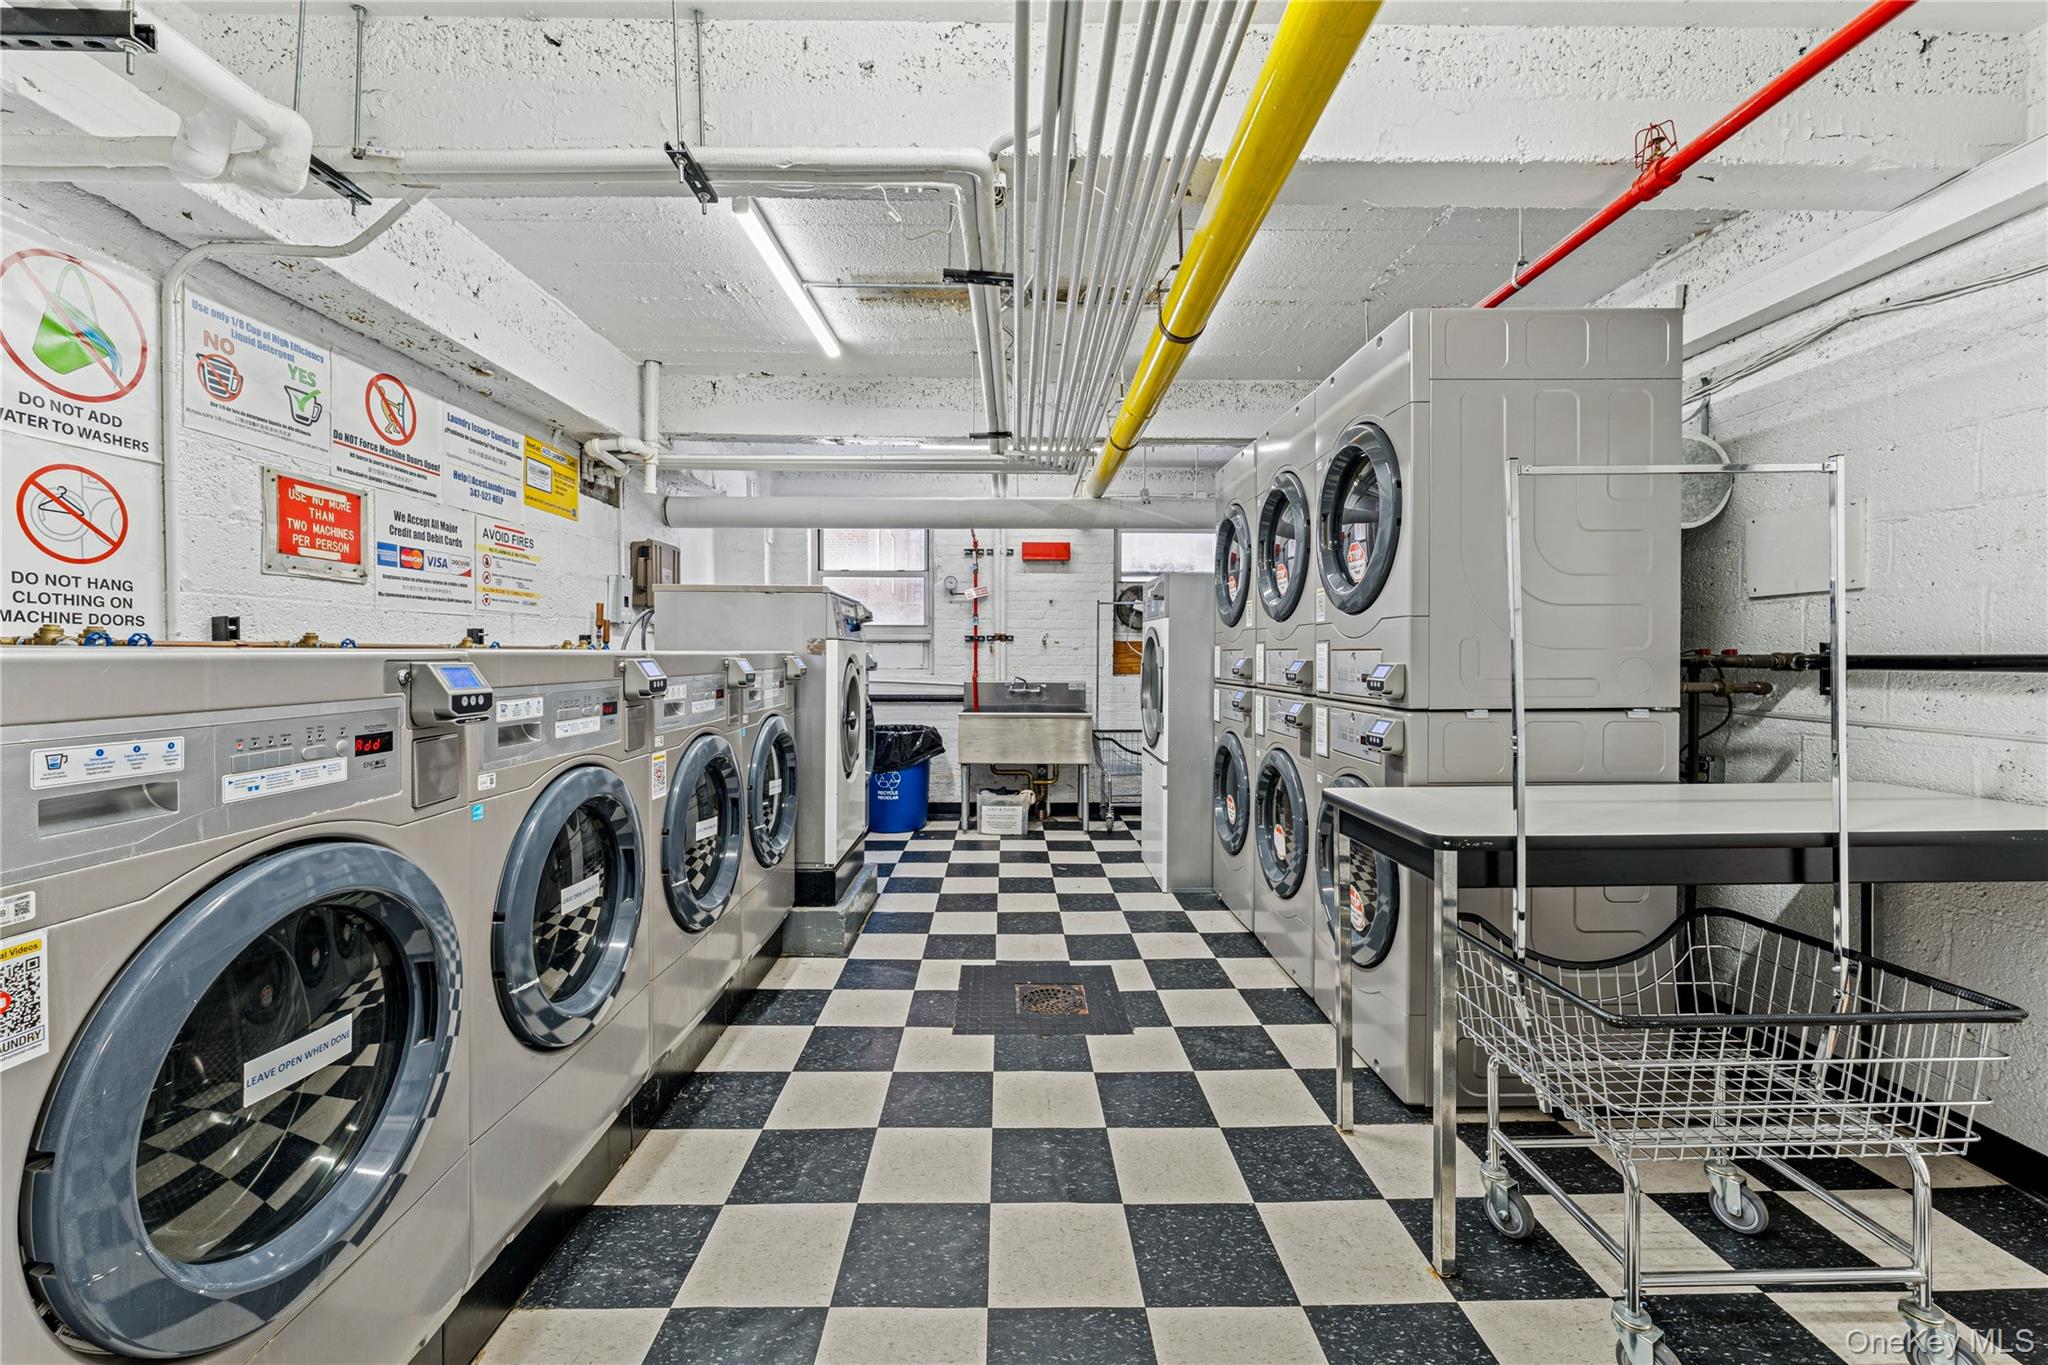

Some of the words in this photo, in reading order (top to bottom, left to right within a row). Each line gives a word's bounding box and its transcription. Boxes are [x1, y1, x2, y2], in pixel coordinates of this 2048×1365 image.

[192, 299, 208, 314] Use
[210, 308, 230, 324] only
[231, 316, 244, 330] 1/8
[246, 324, 262, 338] Cup
[263, 331, 271, 340] of
[272, 334, 289, 349] High
[290, 340, 324, 364] Efficiency
[204, 330, 235, 356] NO
[231, 328, 256, 346] Liquid
[257, 339, 295, 362] Detergent
[288, 363, 317, 388] YES
[18, 391, 45, 408] DO
[50, 399, 84, 418] NOT
[88, 410, 122, 428] ADD
[0, 407, 48, 430] ATER
[52, 420, 74, 435] TO
[77, 426, 149, 453] WASHERS
[448, 412, 470, 430] Laundry
[472, 422, 490, 436] Issue?
[491, 430, 511, 446] Contact
[333, 429, 343, 440] Do
[344, 432, 358, 445] NOT
[360, 438, 378, 452] Force
[380, 444, 405, 461] Machine
[407, 453, 423, 467] Doors
[424, 460, 440, 472] Open!
[453, 470, 516, 498] Help@AcesLaundry.com
[470, 488, 504, 504] 347-527-HELP
[288, 488, 306, 503] USE
[312, 496, 324, 506] NO
[329, 499, 352, 513] MORE
[309, 507, 334, 522] THAN
[394, 510, 406, 522] We
[407, 514, 430, 528] Accept
[440, 520, 458, 534] Major
[287, 517, 307, 532] TWO
[313, 523, 354, 540] MACHINES
[389, 524, 412, 538] Credit
[413, 530, 425, 541] and
[427, 532, 444, 544] Debit
[445, 536, 463, 548] Cards
[483, 528, 509, 543] AVOID
[512, 535, 534, 549] FIRES
[292, 534, 310, 547] PER
[316, 538, 349, 553] PERSON
[427, 555, 448, 569] VISA
[12, 571, 39, 585] DO
[45, 573, 81, 588] NOT
[88, 577, 133, 592] HANG
[12, 590, 105, 607] CLOTHING
[110, 597, 133, 608] ON
[0, 609, 83, 624] MACHINE
[89, 613, 145, 626] DOORS
[355, 738, 381, 752] Add
[9, 943, 38, 956] Videos
[246, 1068, 276, 1088] LEAVE
[278, 1054, 302, 1072] OPEN
[304, 1042, 329, 1060] WHEN
[330, 1029, 351, 1047] DONE
